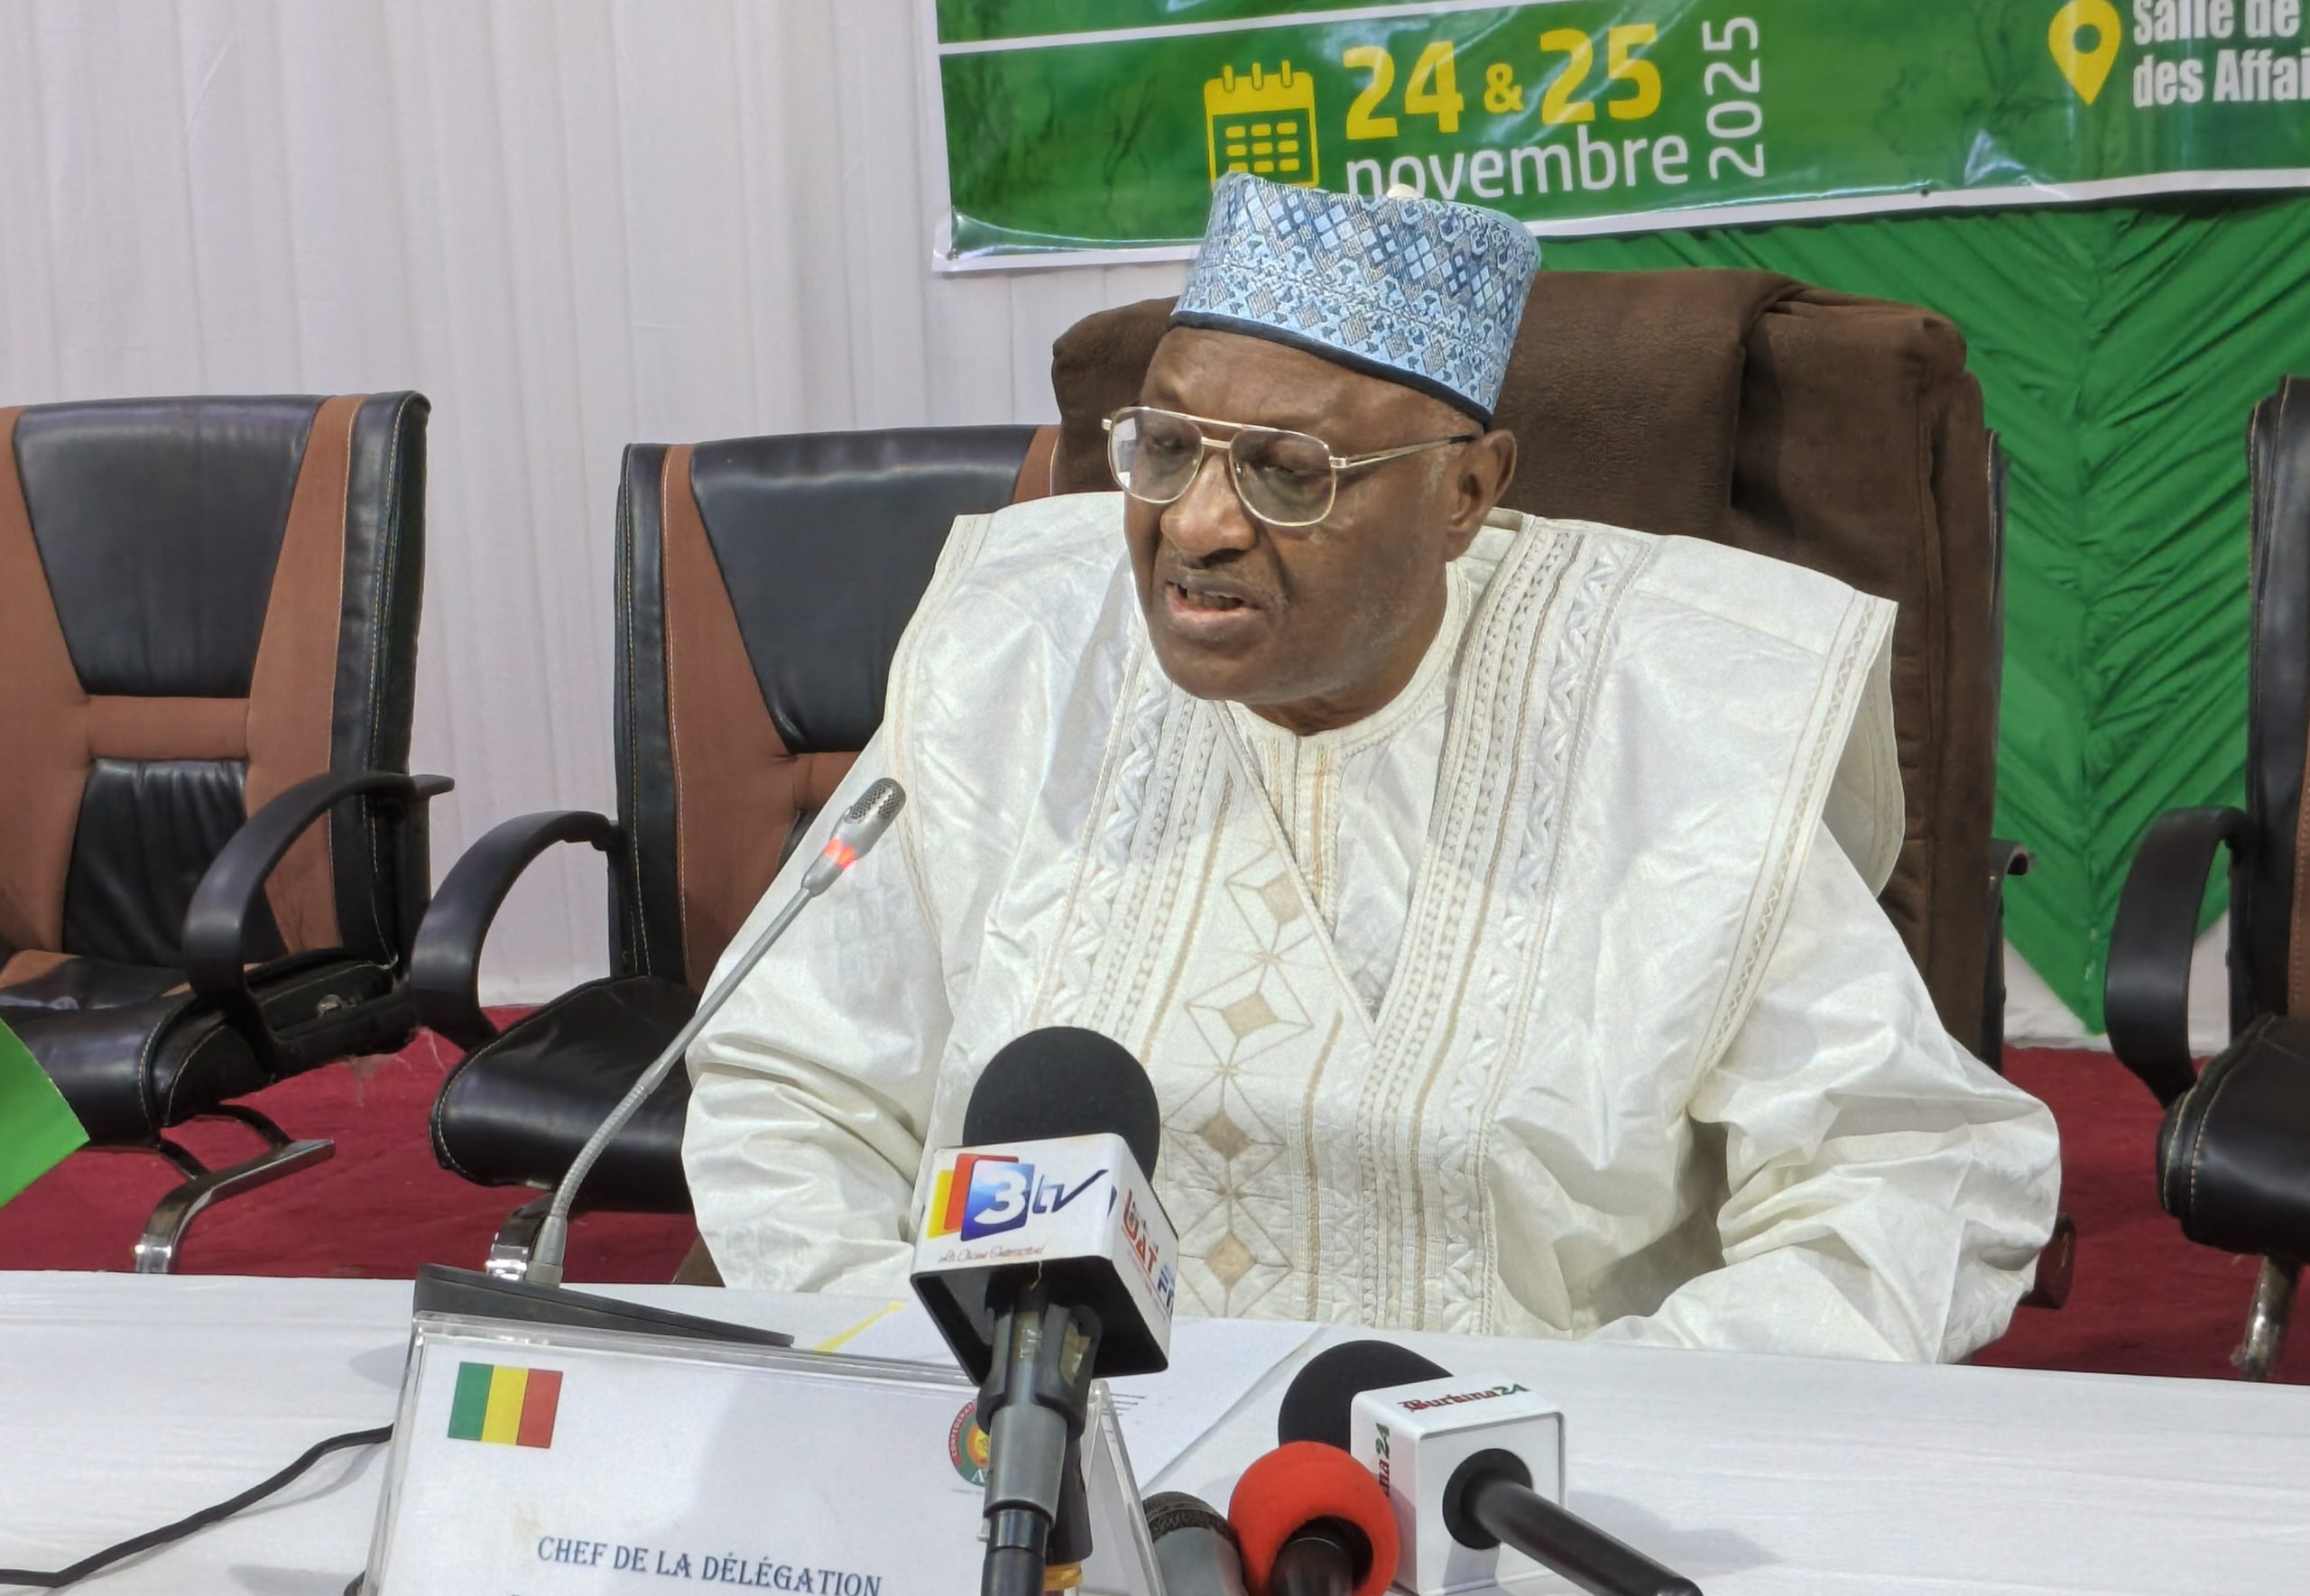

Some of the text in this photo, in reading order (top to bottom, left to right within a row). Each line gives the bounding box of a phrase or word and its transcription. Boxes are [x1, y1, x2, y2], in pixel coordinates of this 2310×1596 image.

[2133, 0, 2299, 44] Salle de
[1343, 23, 1661, 140] 24 & 25
[1703, 16, 1764, 180] 2025
[2133, 54, 2204, 107] des
[1346, 125, 1688, 200] novembre
[539, 1536, 882, 1596] CHEF DE LA DÉLÉGATION
